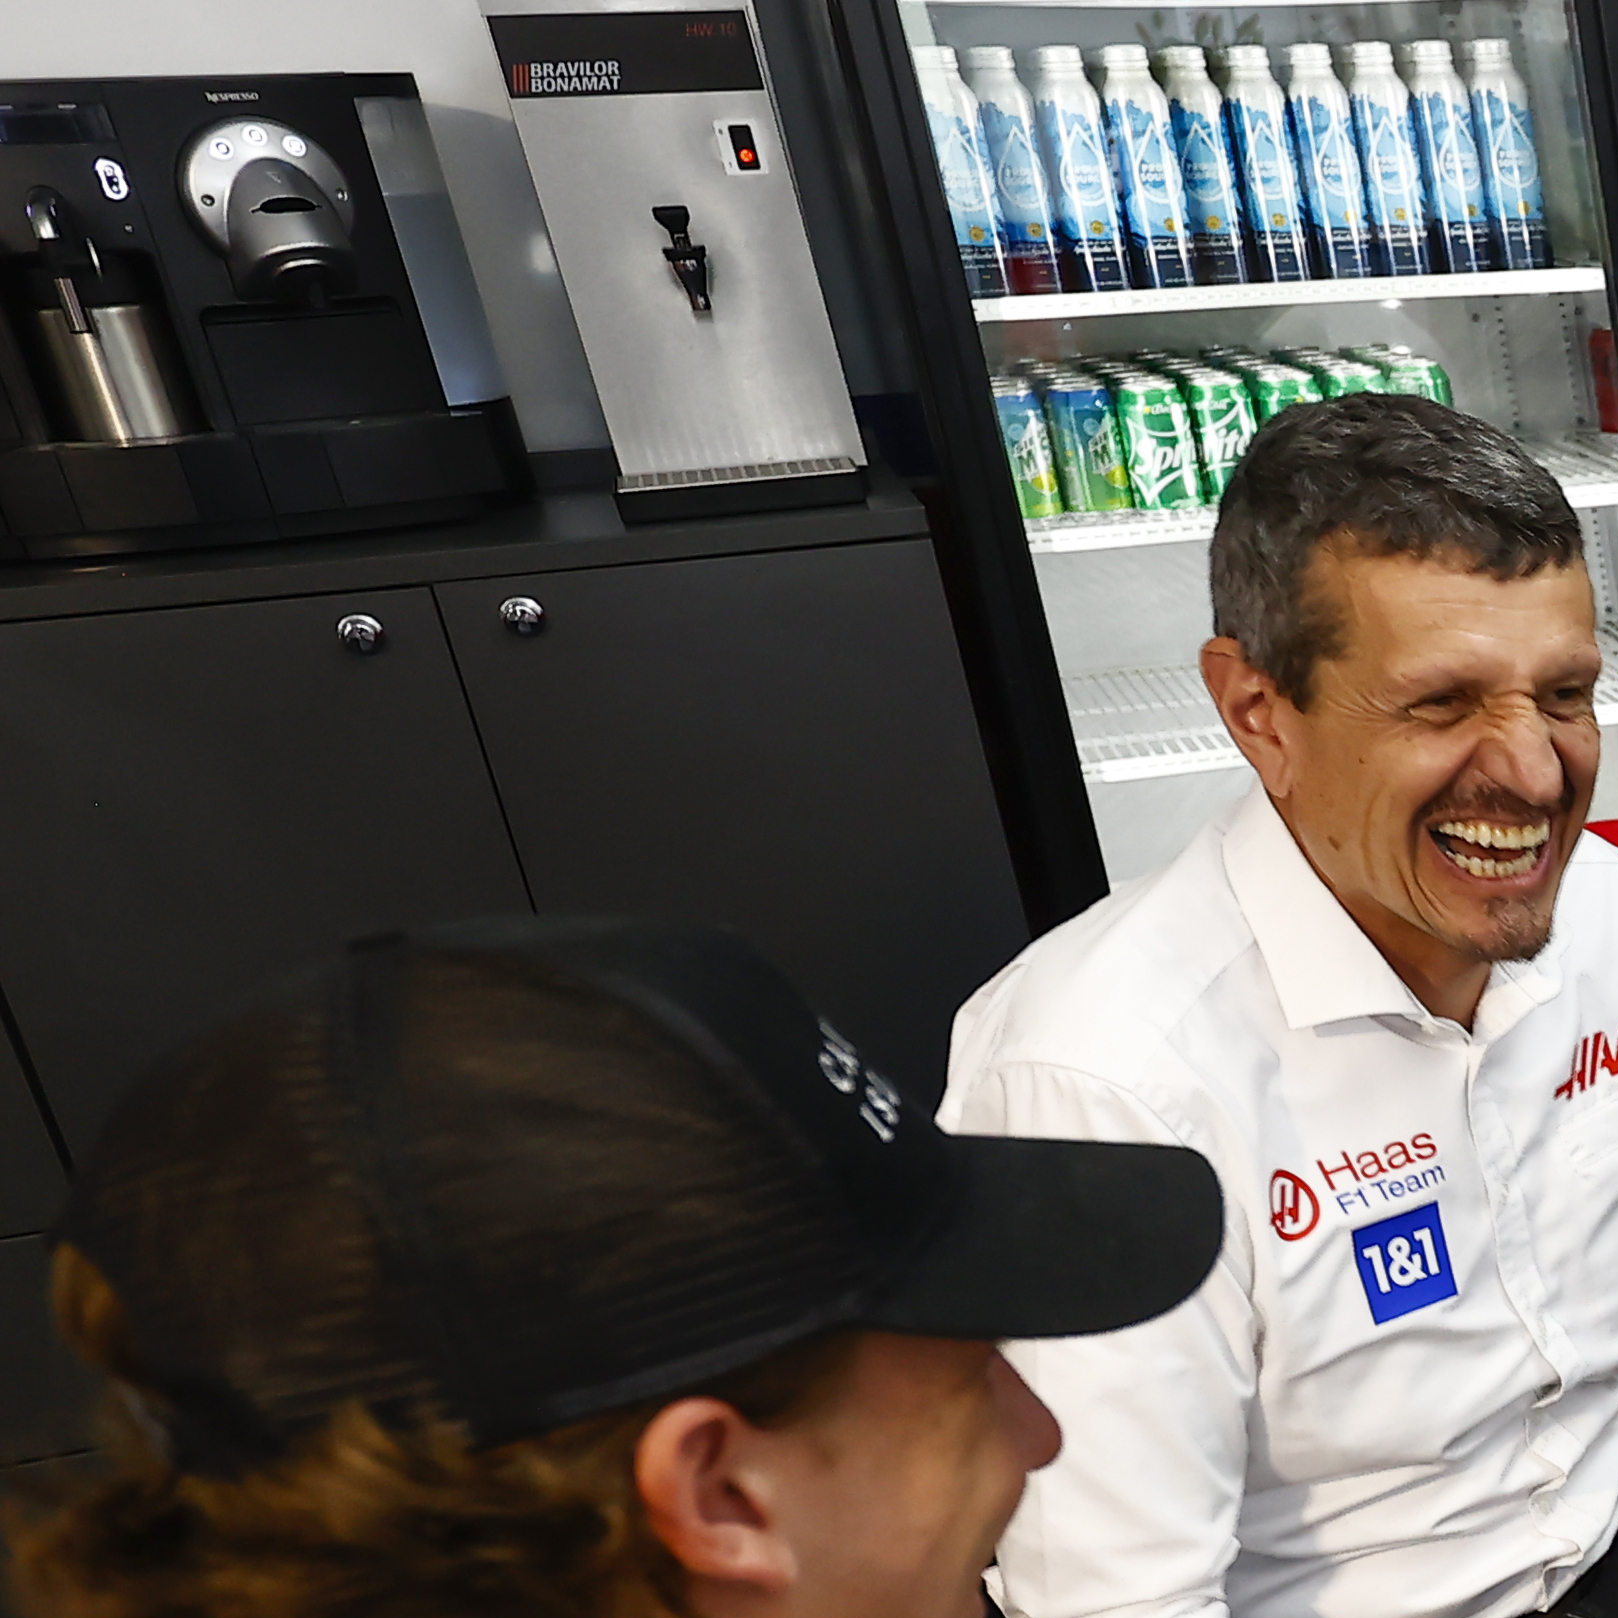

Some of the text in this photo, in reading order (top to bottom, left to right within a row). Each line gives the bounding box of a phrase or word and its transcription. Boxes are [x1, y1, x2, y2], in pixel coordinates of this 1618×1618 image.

[685, 22, 737, 37] HW 10
[530, 60, 620, 78] BRAVILOR
[530, 75, 621, 93] BONAMAT
[1315, 1131, 1440, 1192] Haas
[1335, 1163, 1447, 1216] F1 Team
[1362, 1227, 1442, 1295] 1&1
